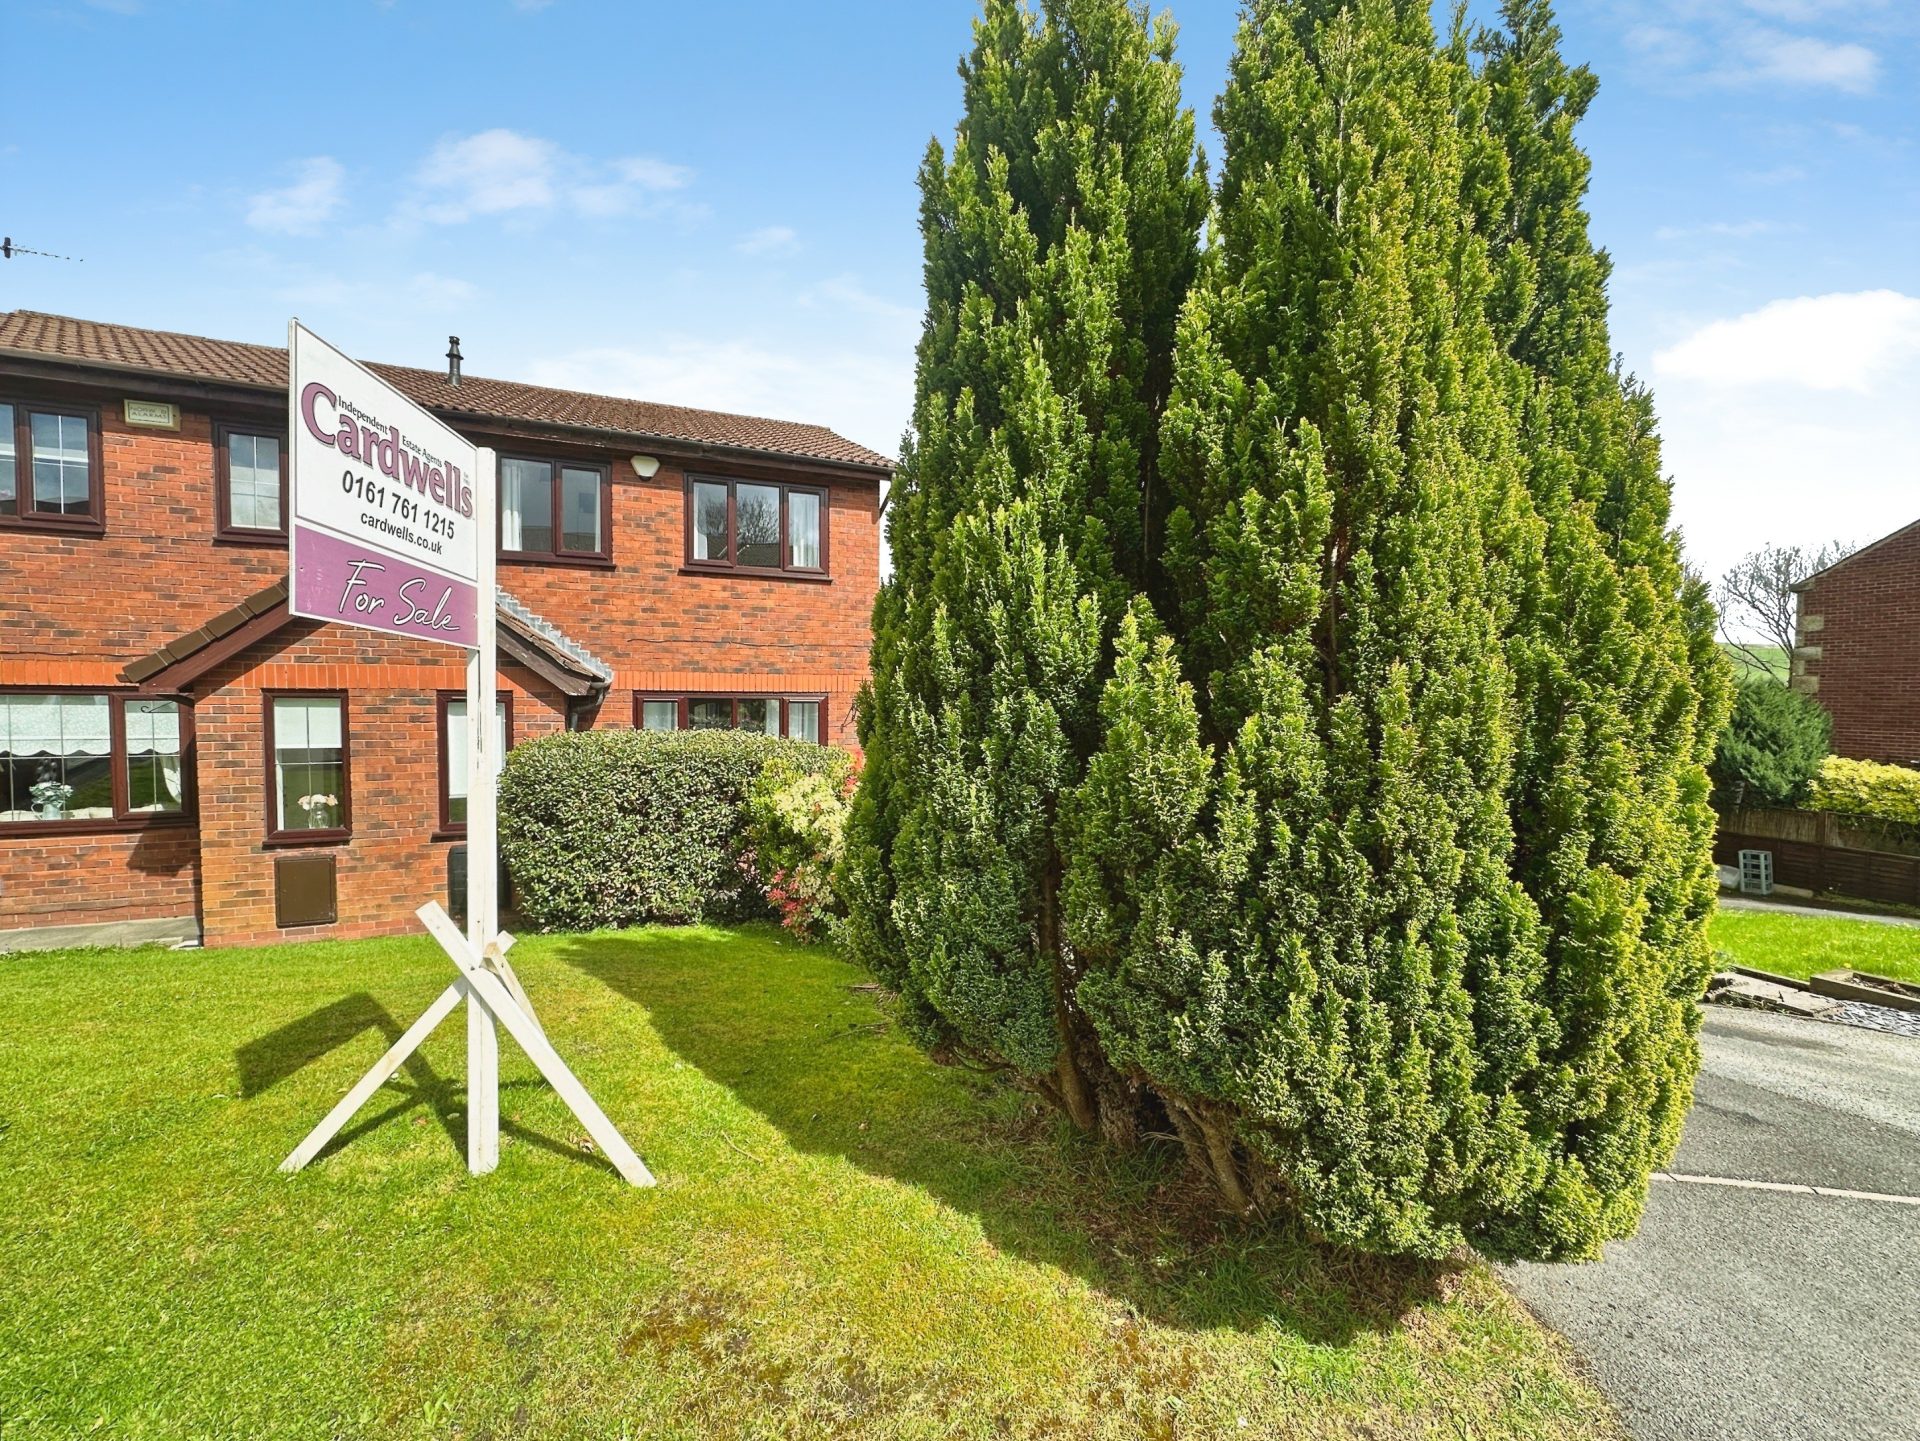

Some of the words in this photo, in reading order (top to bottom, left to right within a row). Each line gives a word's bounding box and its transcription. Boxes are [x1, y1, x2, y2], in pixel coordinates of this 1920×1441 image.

[301, 382, 473, 519] Cardwells
[338, 395, 389, 435] Independent
[402, 435, 421, 455] Estate
[422, 448, 443, 468] Agents
[342, 470, 385, 508] 0161
[392, 492, 418, 523] 761
[424, 509, 455, 539] 1215
[361, 513, 442, 555] cardwells.co.uk
[339, 559, 386, 614] For
[393, 578, 460, 631] Sale
